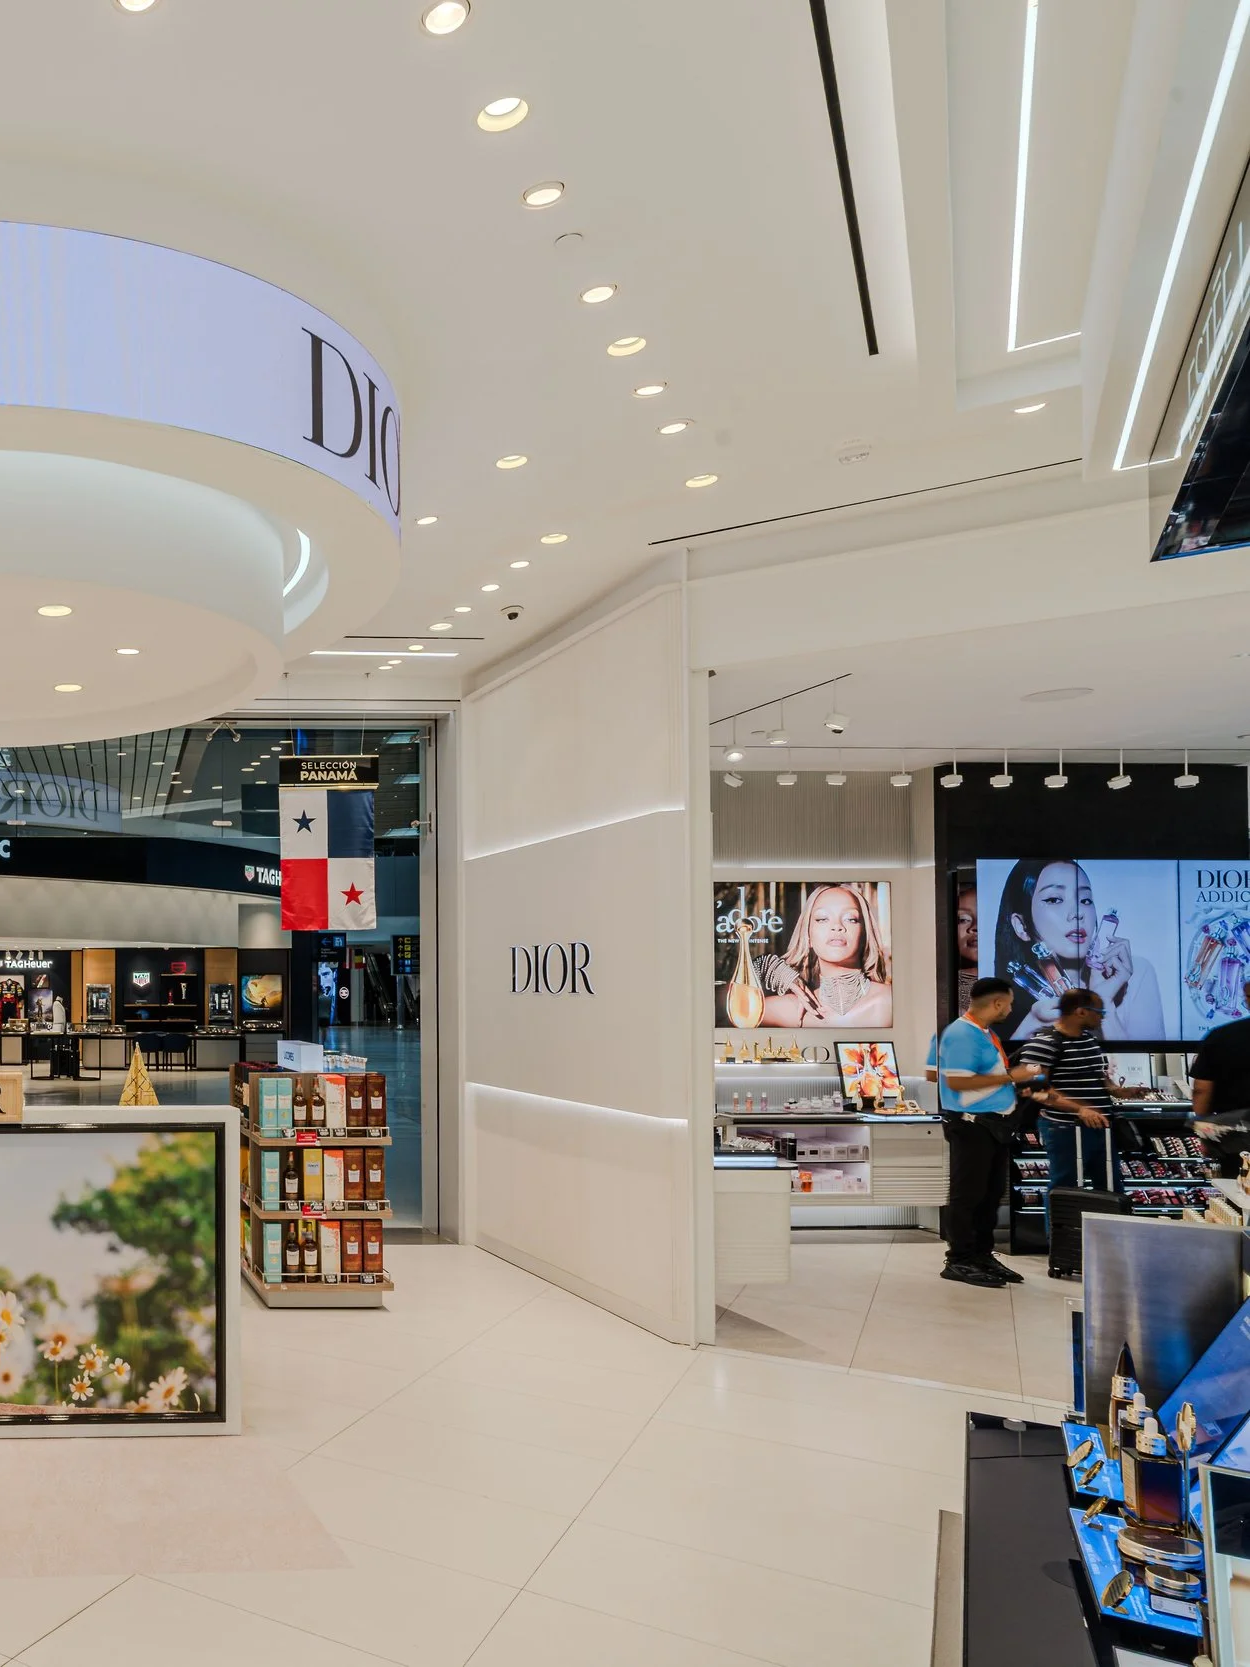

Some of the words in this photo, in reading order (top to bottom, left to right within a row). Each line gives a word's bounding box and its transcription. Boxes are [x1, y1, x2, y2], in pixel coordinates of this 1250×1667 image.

[300, 326, 400, 517] DIO
[301, 761, 357, 770] SELECCIÓN
[300, 768, 358, 781] PANAMÁ
[256, 866, 281, 886] TAGH
[1196, 890, 1250, 903] ADDIC
[509, 941, 596, 995] DIOR
